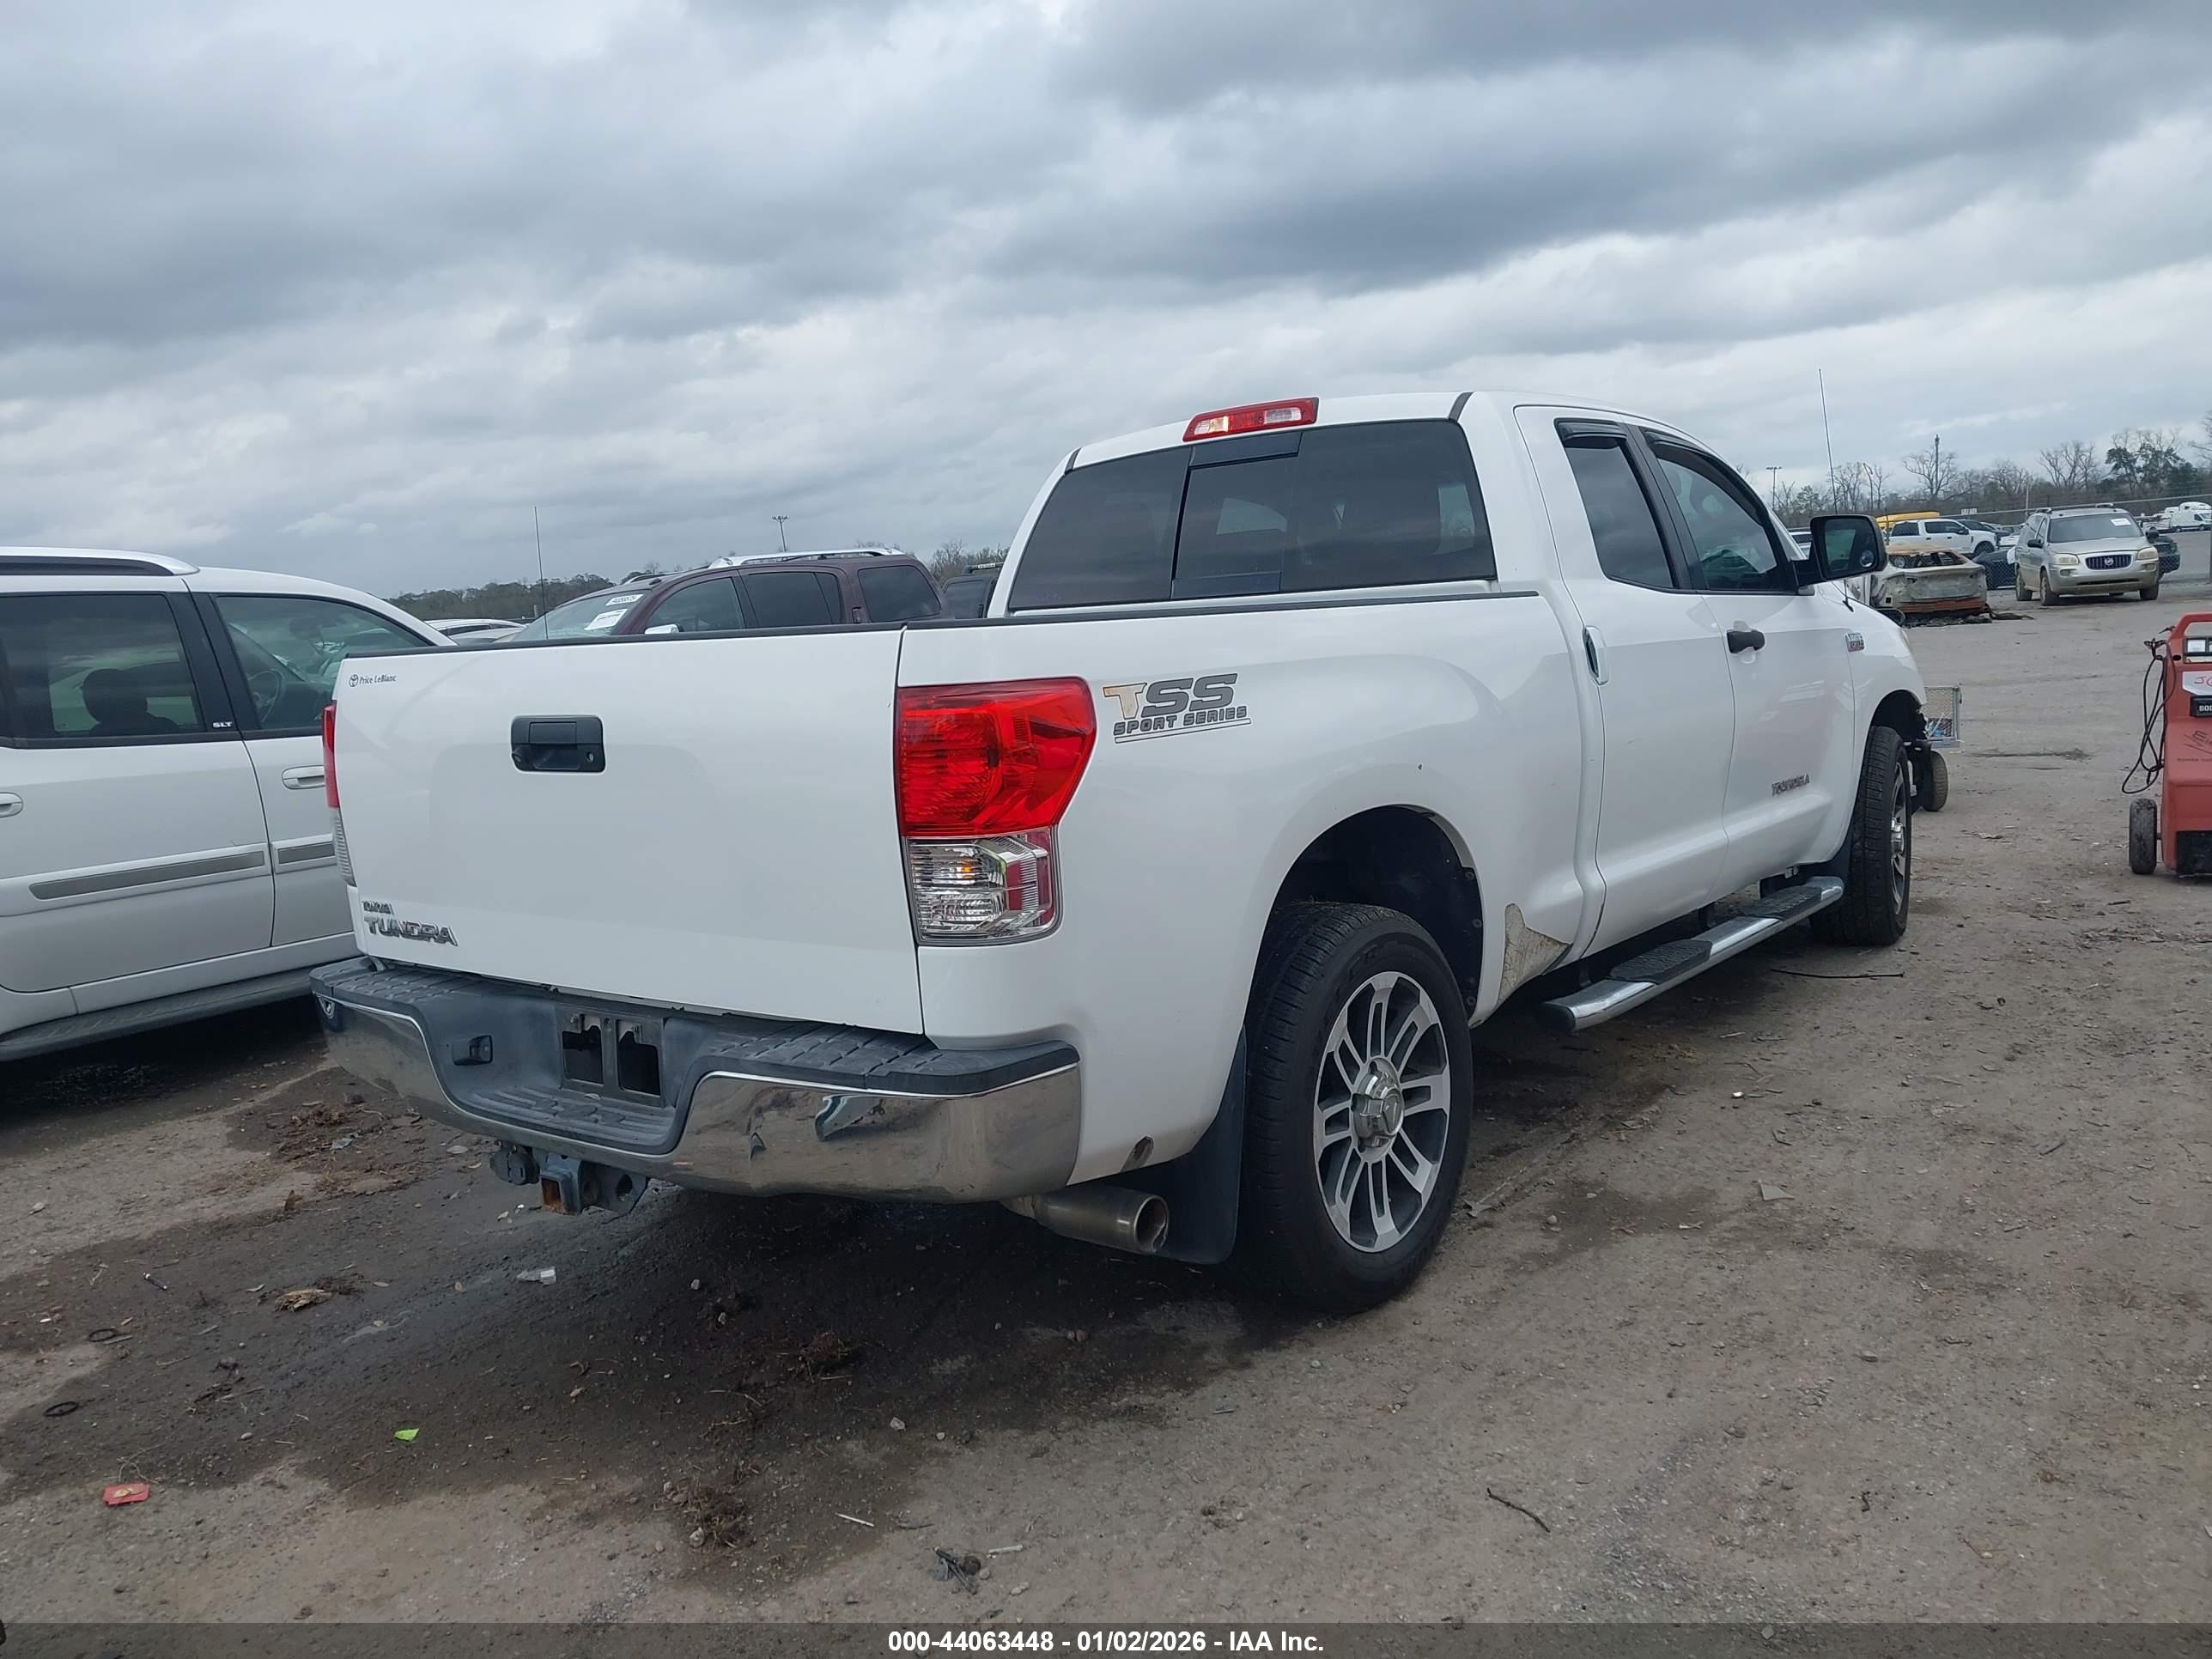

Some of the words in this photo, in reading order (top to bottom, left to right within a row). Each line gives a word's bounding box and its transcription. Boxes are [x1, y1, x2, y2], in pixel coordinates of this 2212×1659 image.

[359, 675, 373, 685] Price
[374, 673, 397, 684] LeBlanc
[1103, 673, 1238, 720] TSS
[1113, 715, 1177, 737] SPORT
[1182, 705, 1248, 726] SERIES
[363, 915, 459, 947] TUNDRA
